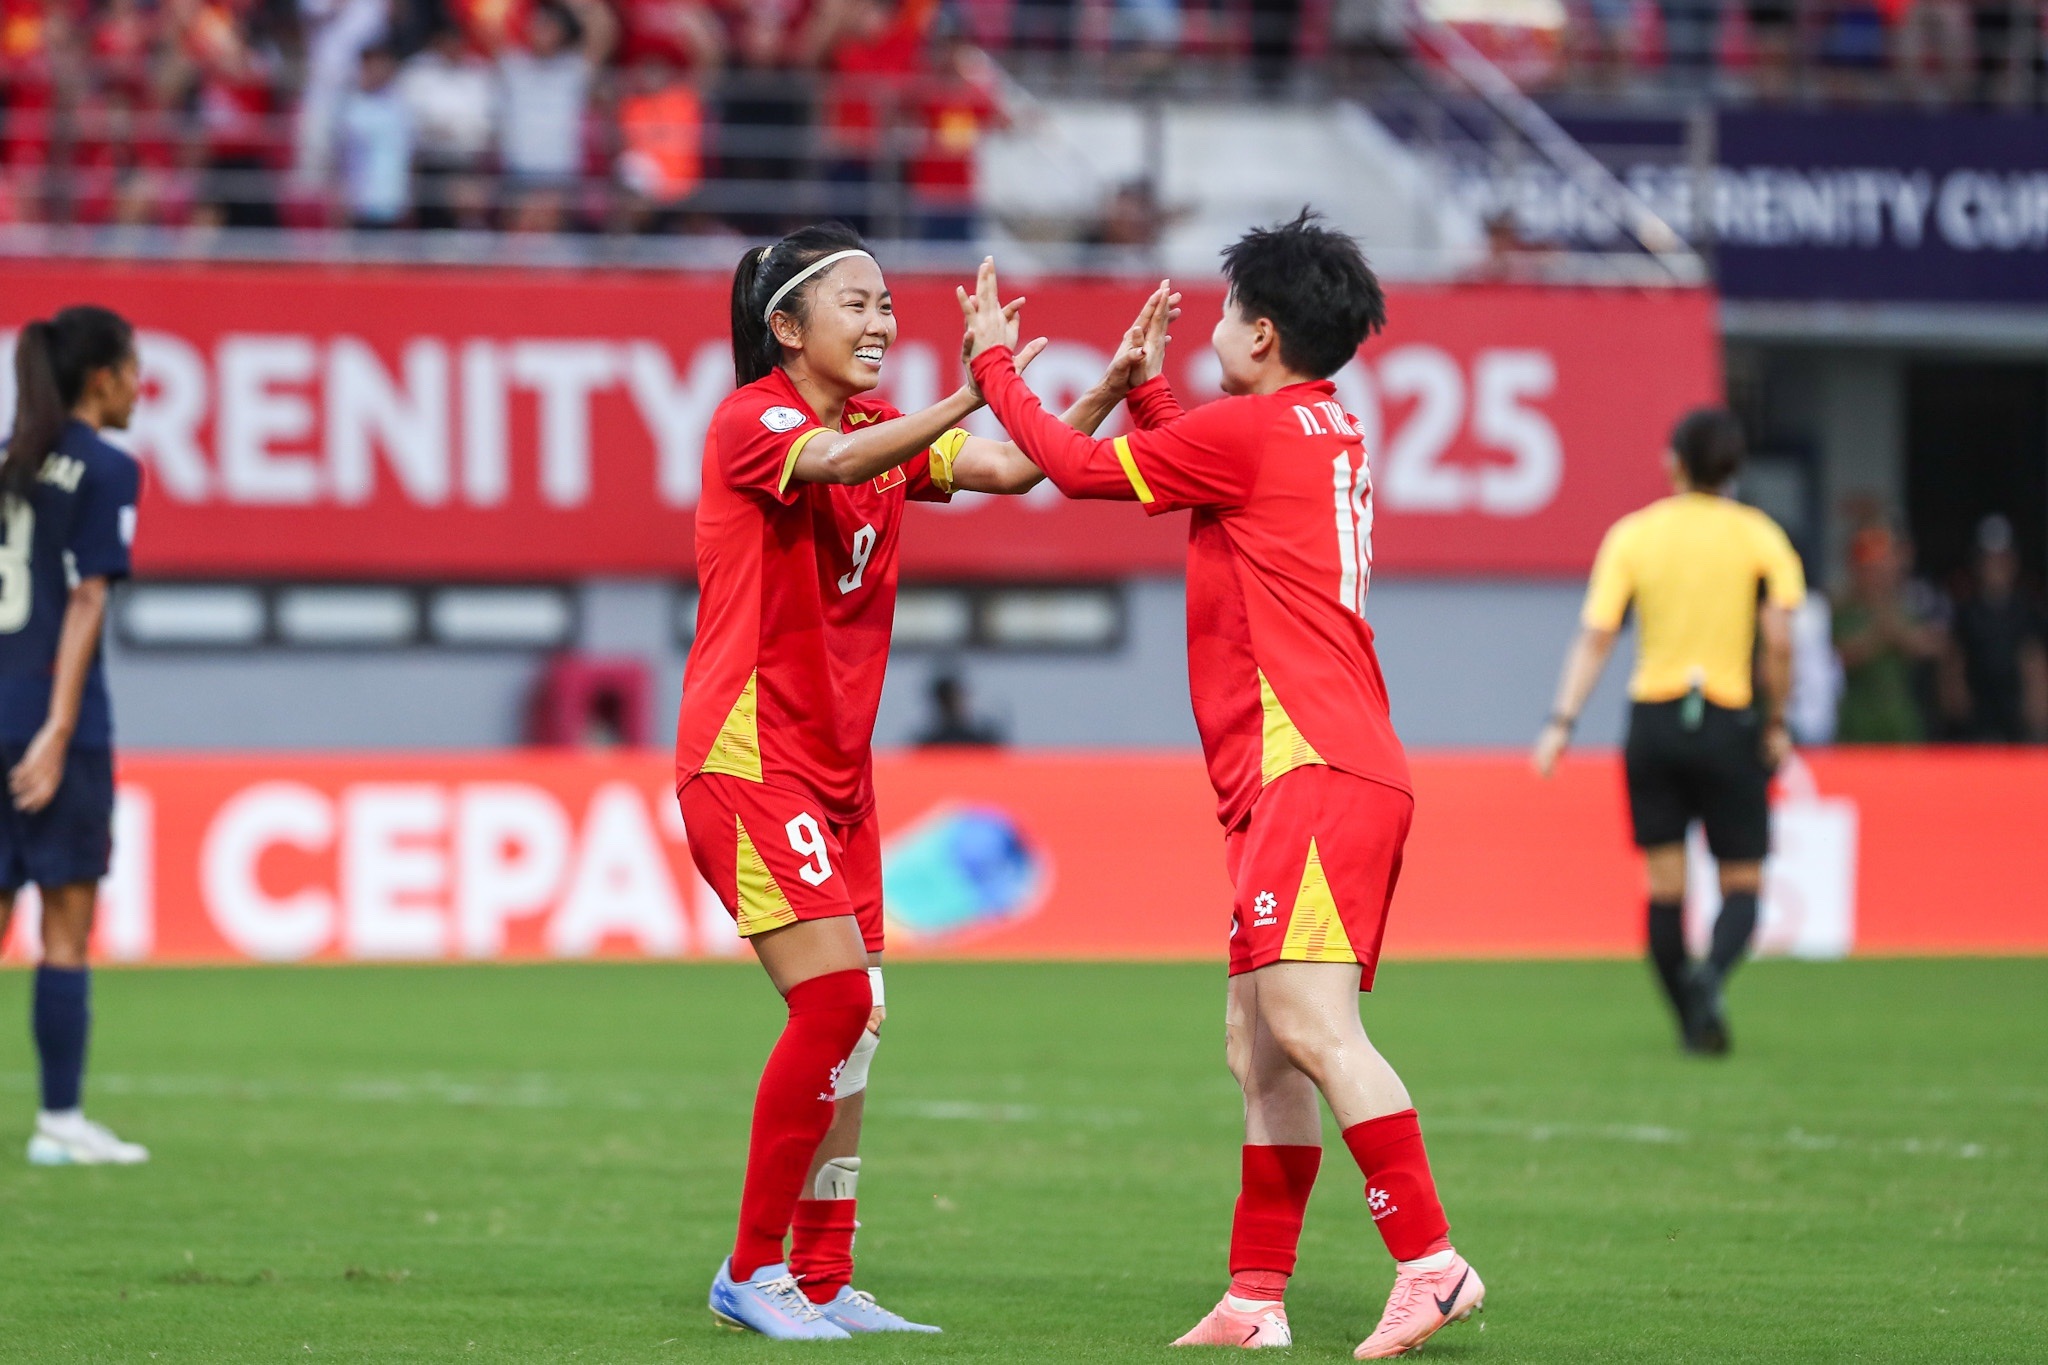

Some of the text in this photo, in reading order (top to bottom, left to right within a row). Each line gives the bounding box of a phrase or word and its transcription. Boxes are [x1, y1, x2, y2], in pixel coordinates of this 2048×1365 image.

[0, 329, 738, 509] RENITY
[1184, 344, 1565, 517] 25
[838, 523, 876, 595] 9
[784, 811, 833, 887] 9
